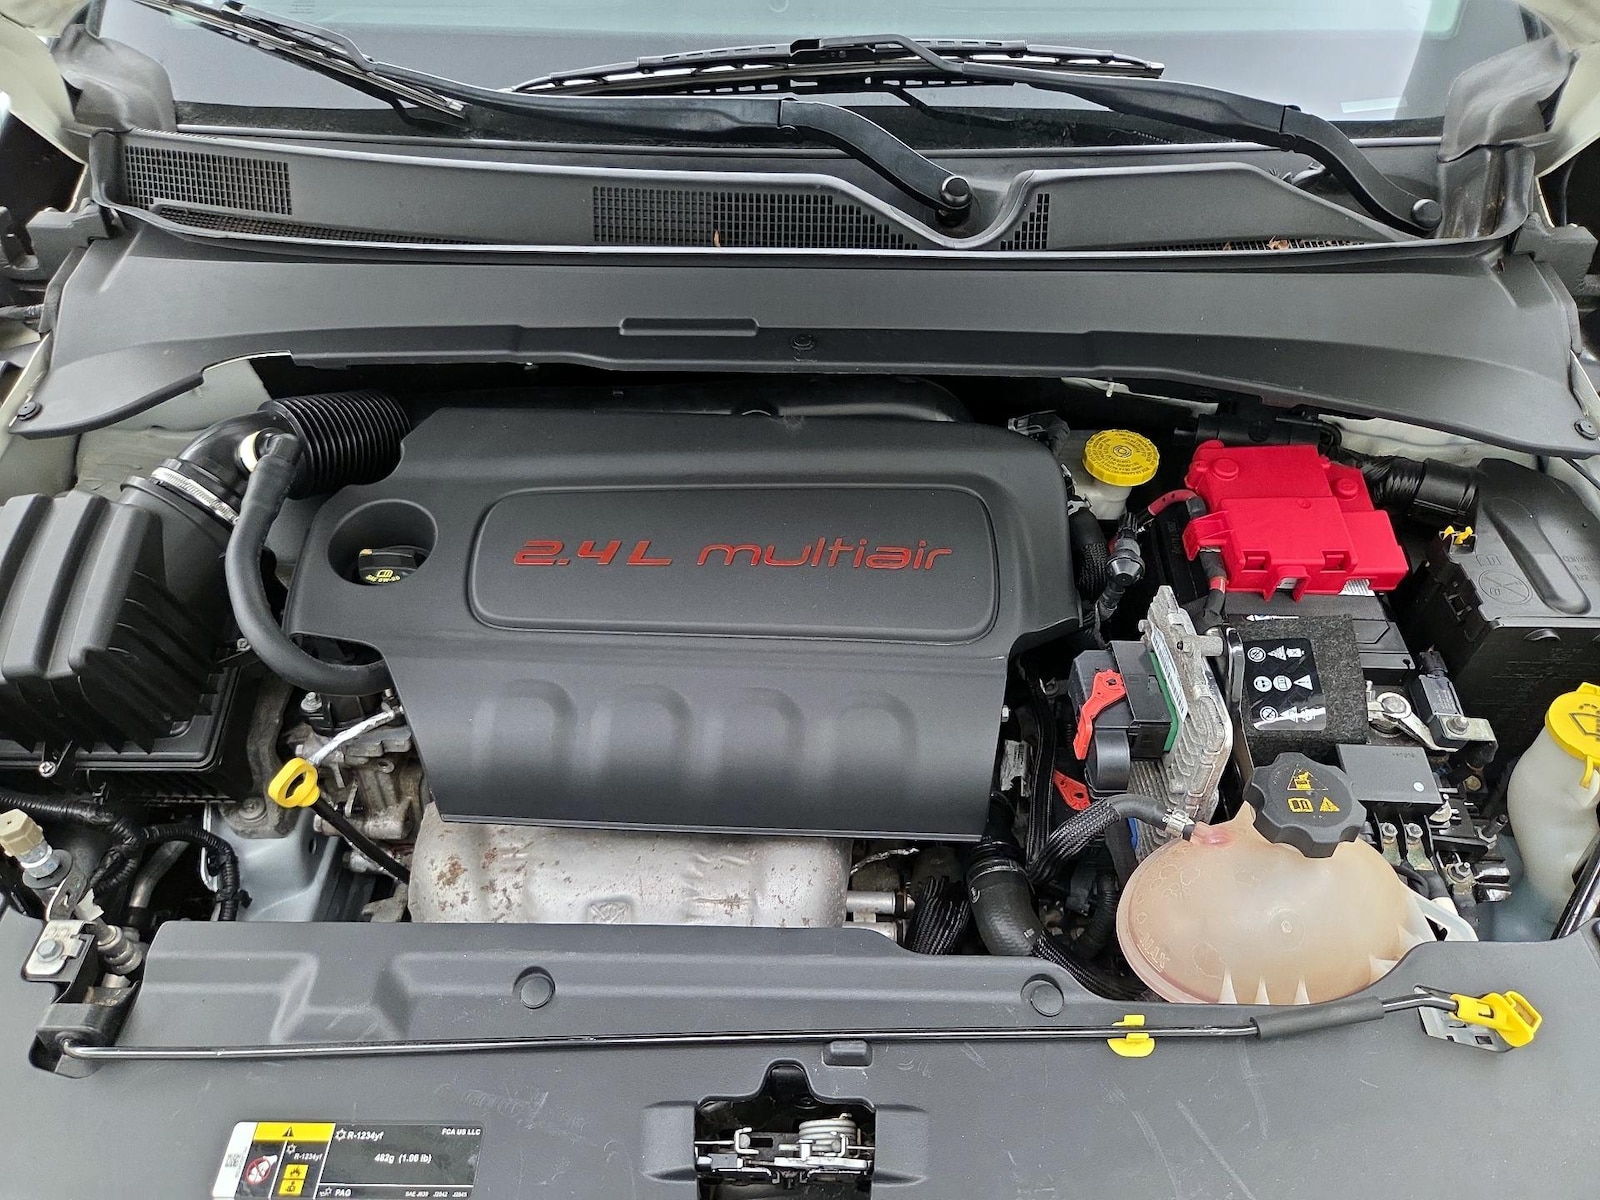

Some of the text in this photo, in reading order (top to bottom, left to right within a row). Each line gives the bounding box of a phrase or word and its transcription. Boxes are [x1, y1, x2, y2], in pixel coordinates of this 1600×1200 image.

[696, 536, 952, 570] multiair
[347, 1131, 384, 1142] R-1234yf
[441, 1128, 481, 1136] FCA US LLC
[293, 1152, 323, 1161] R-1234yf
[374, 1153, 432, 1165] 482g (1.06 lb)
